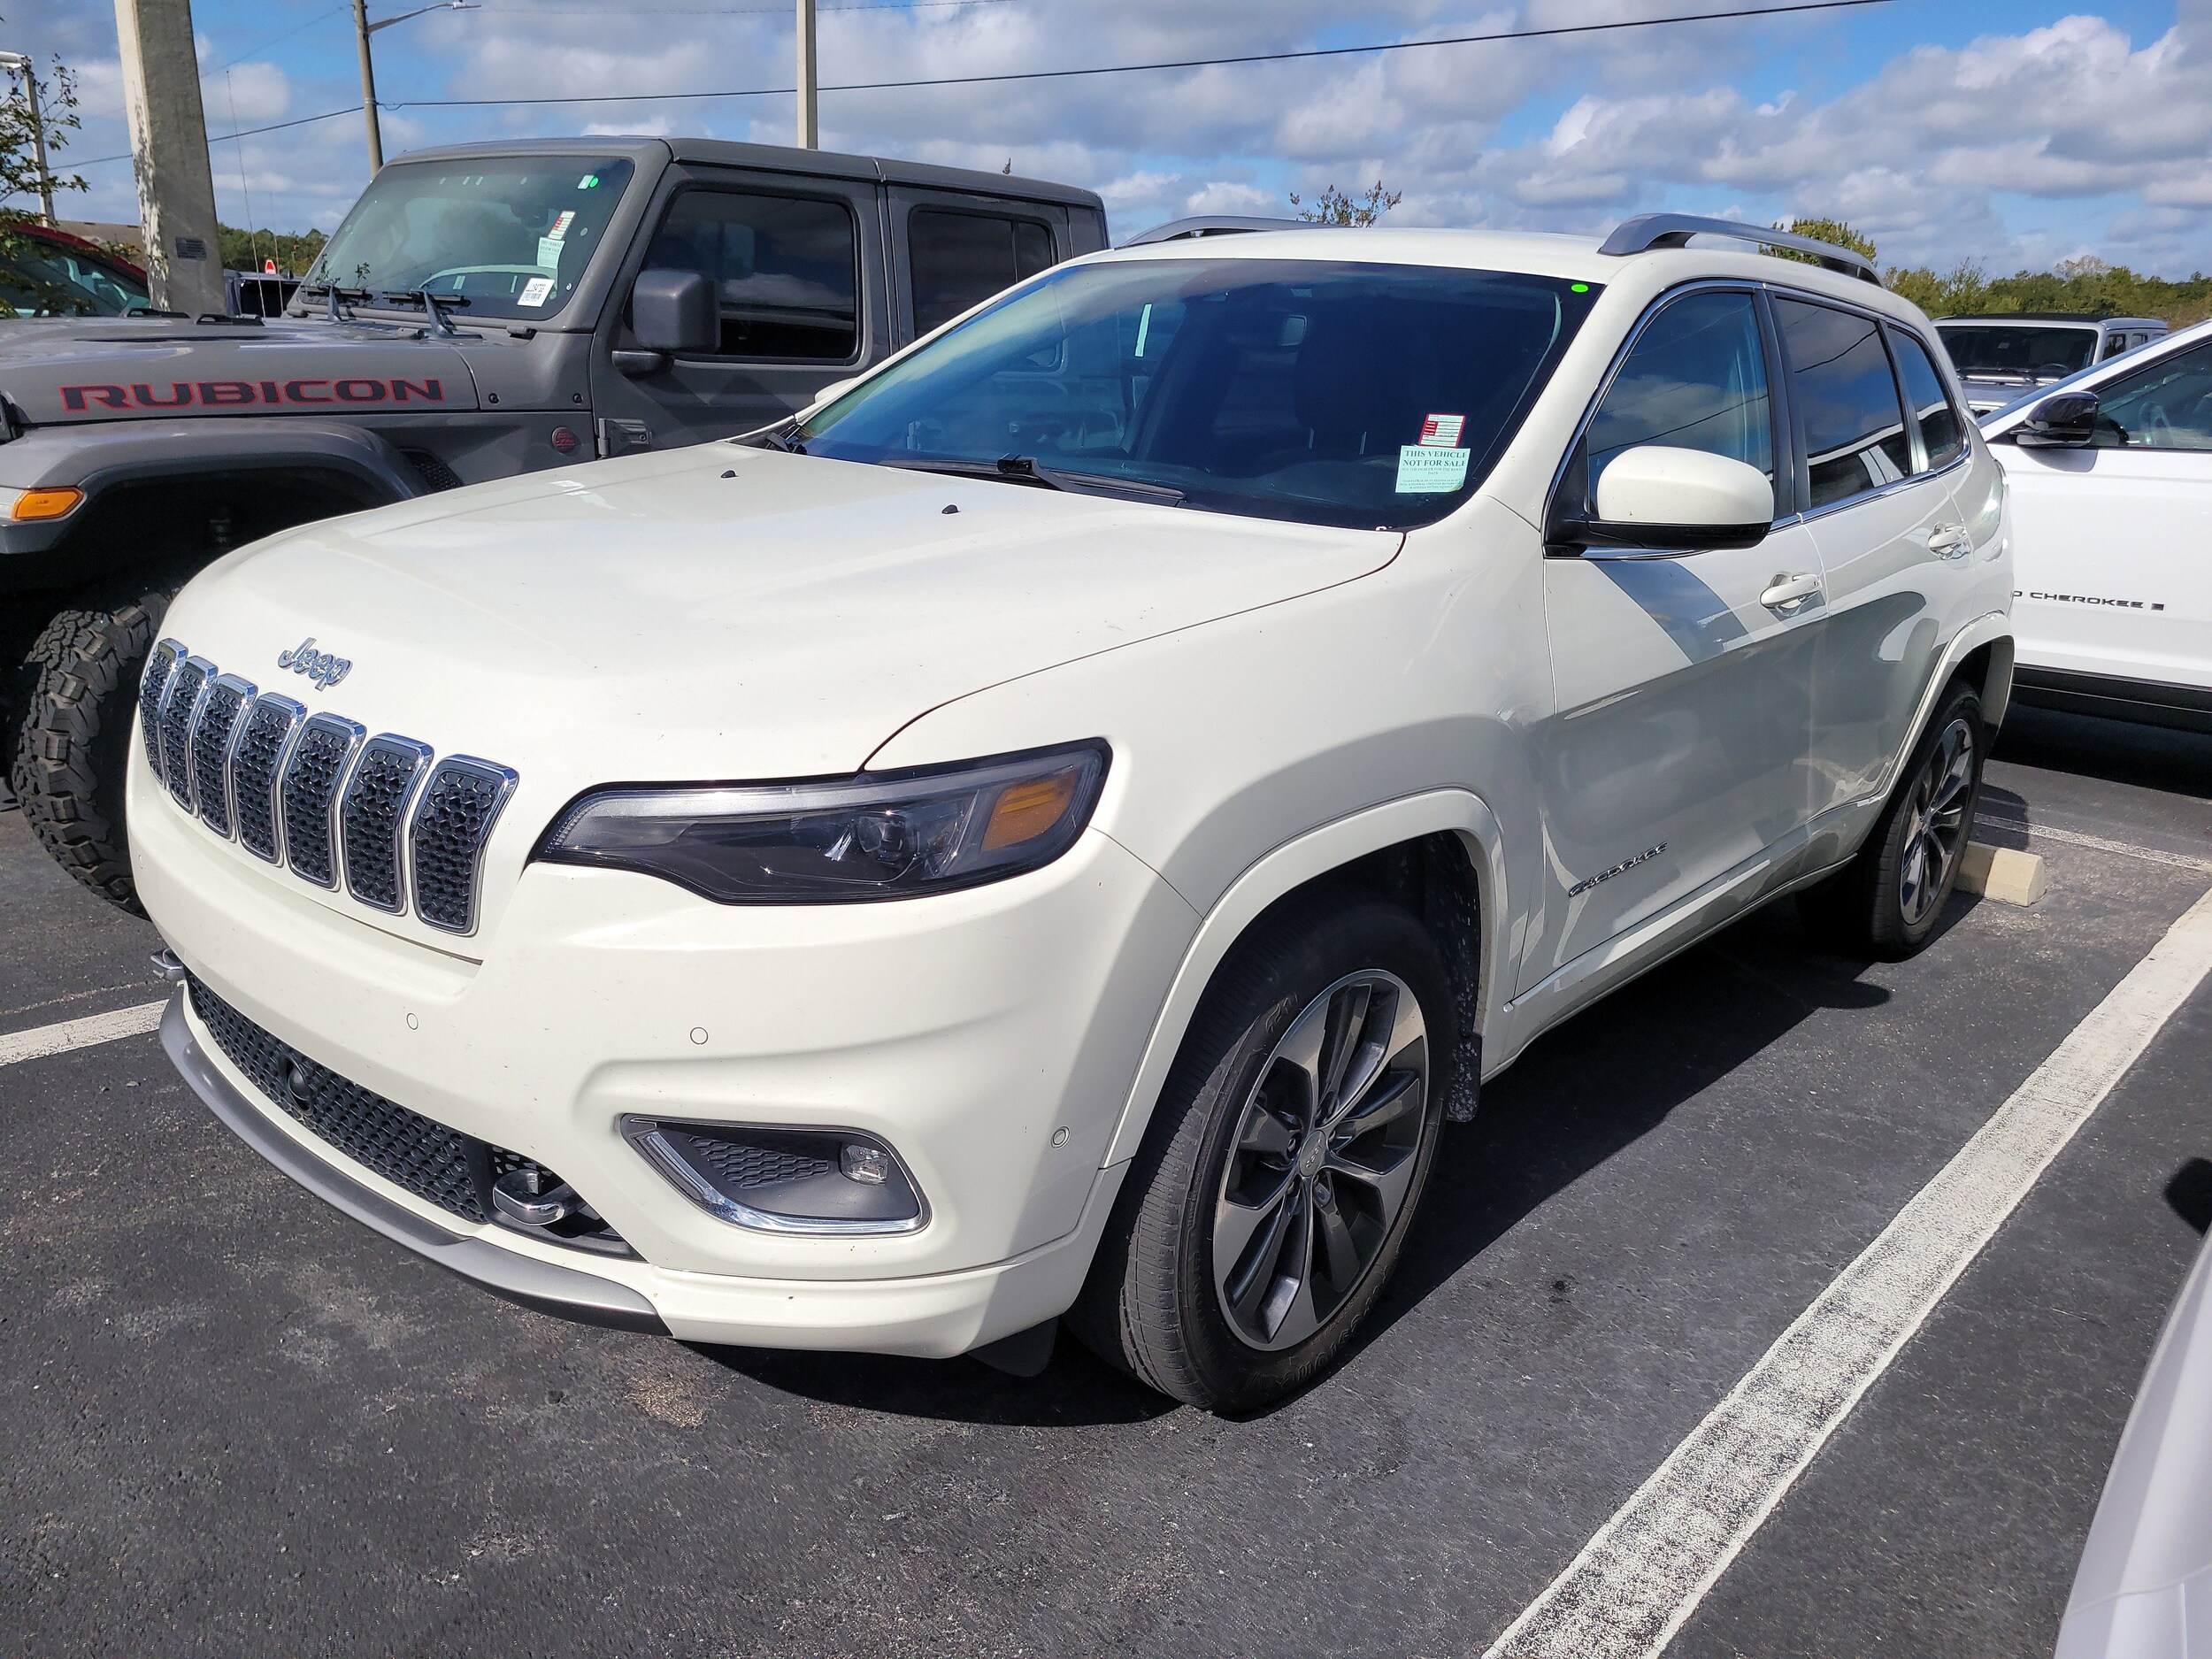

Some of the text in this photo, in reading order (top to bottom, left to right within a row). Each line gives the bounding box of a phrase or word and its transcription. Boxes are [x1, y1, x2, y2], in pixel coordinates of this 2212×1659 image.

[59, 378, 445, 412] RUBICON
[2030, 592, 2144, 609] CHEROKEE
[278, 637, 353, 692] Jeep
[1568, 841, 1668, 897] CHEROKEE
